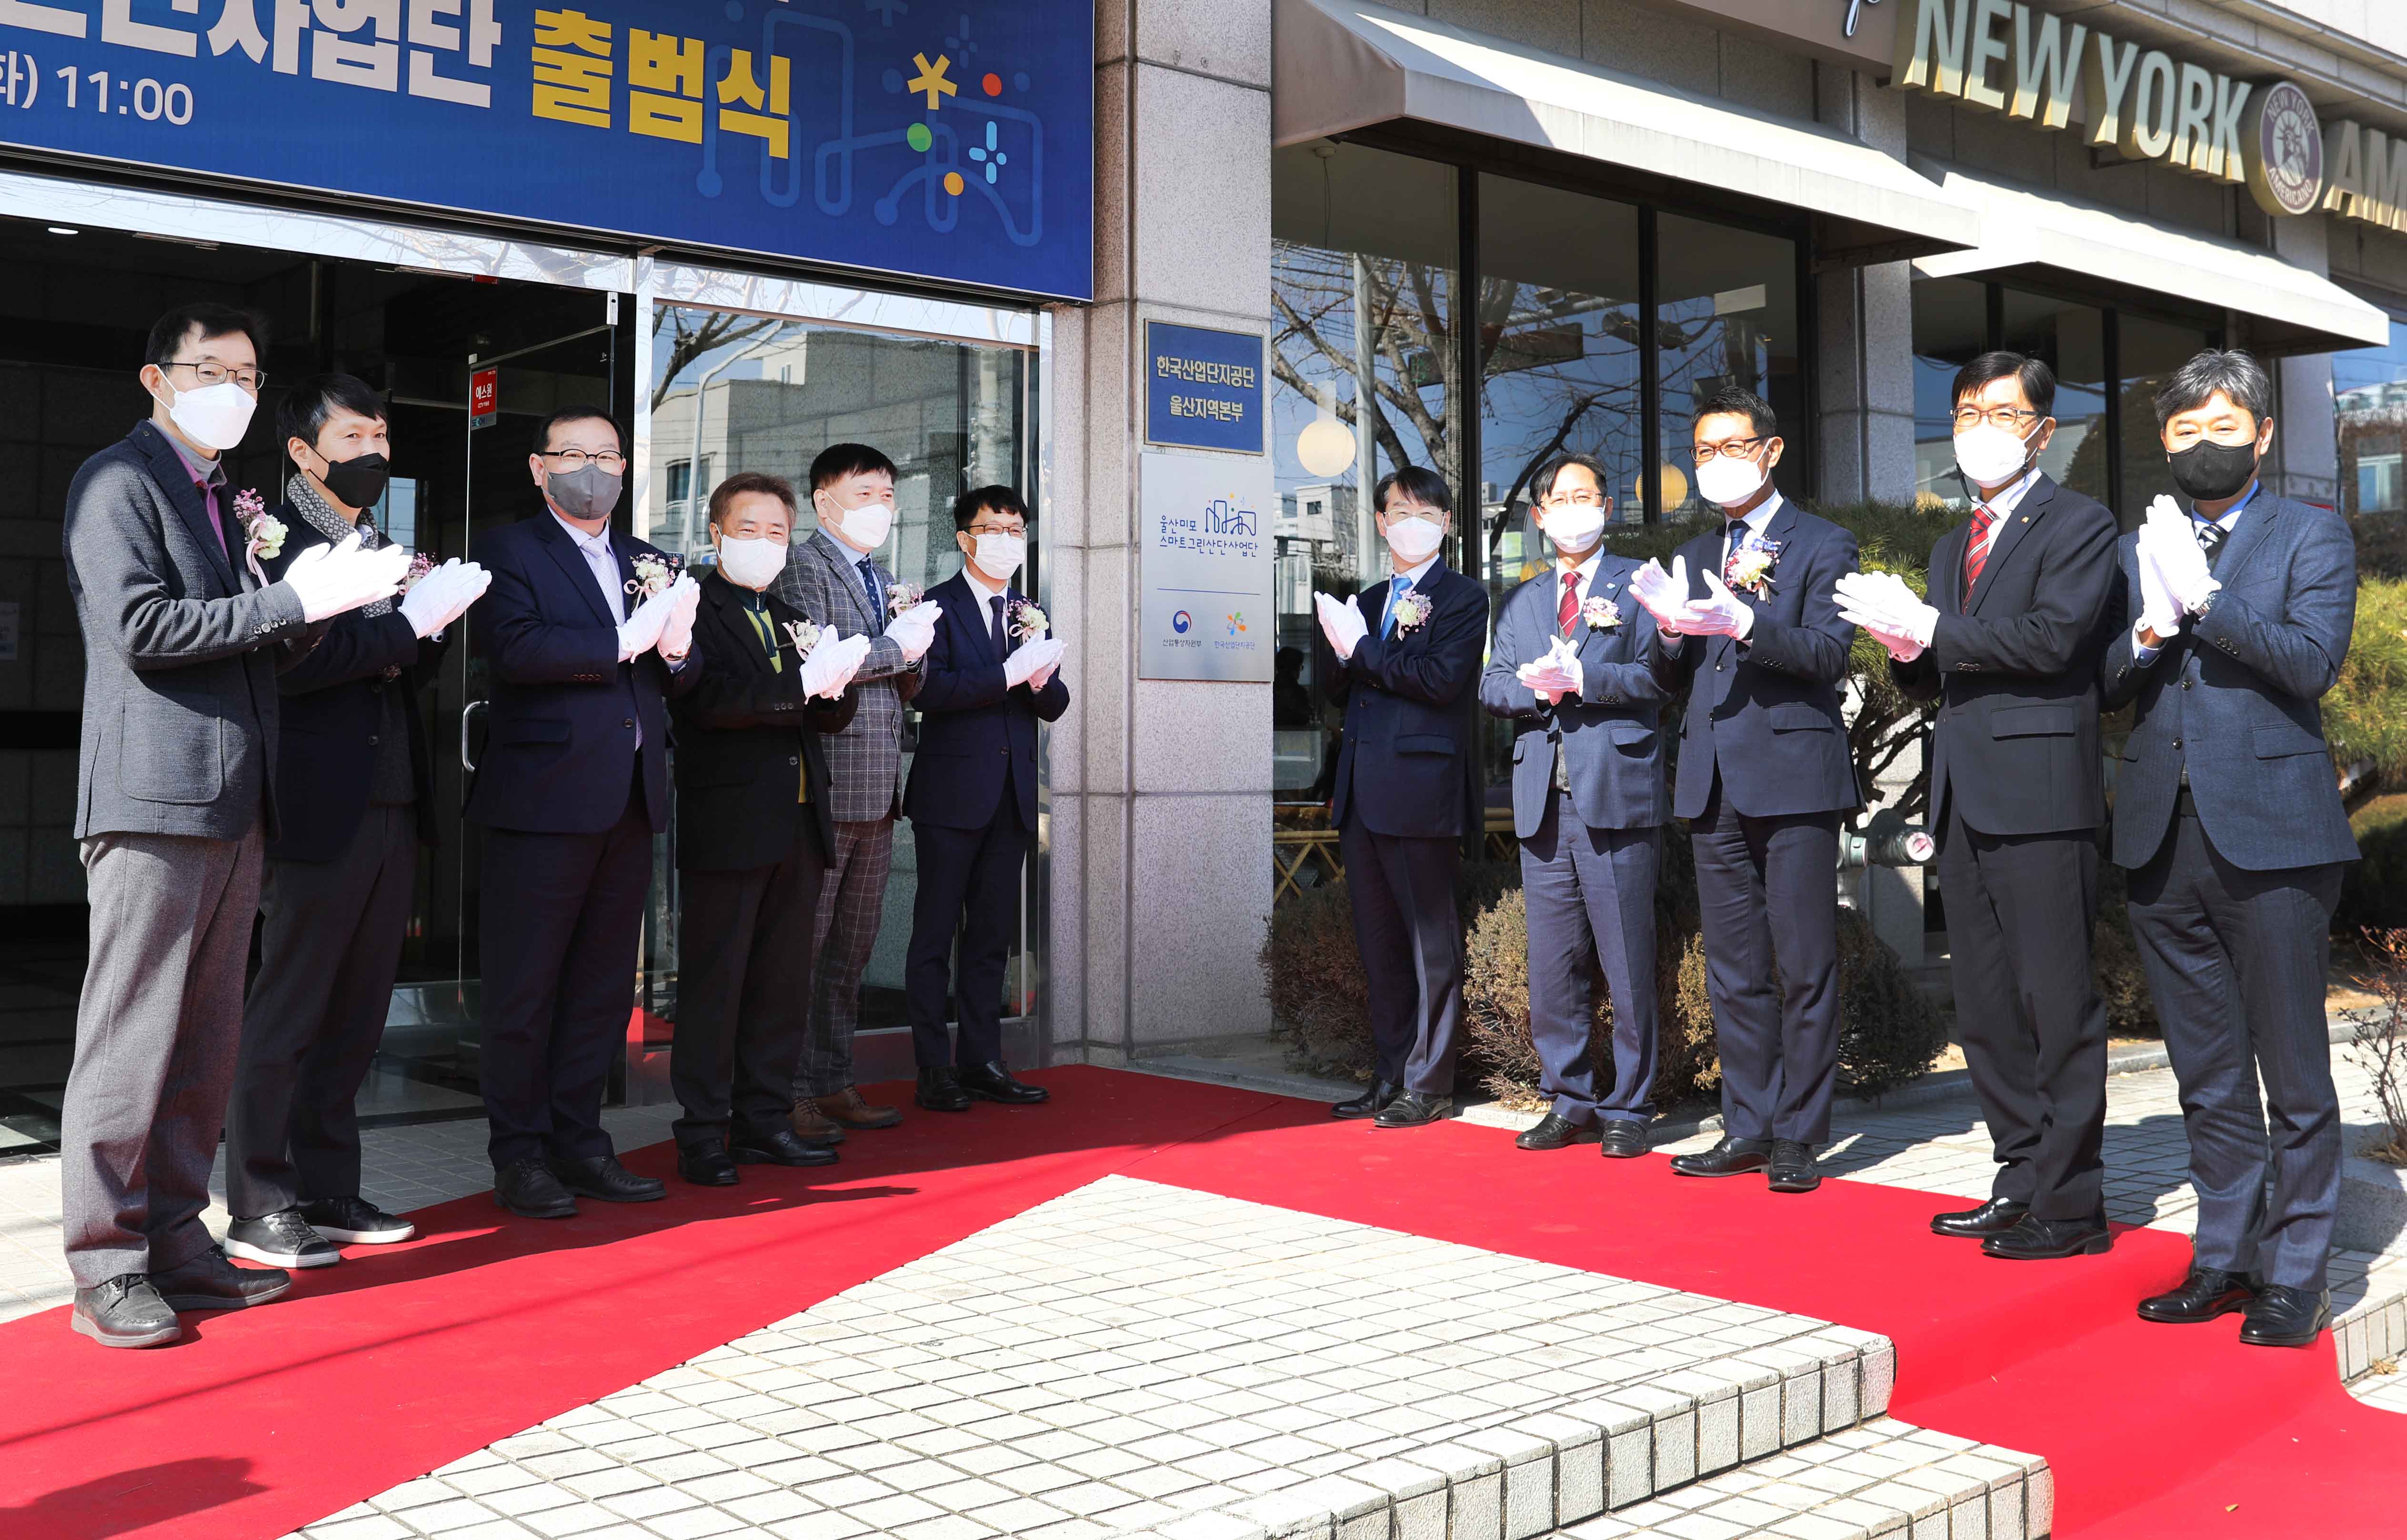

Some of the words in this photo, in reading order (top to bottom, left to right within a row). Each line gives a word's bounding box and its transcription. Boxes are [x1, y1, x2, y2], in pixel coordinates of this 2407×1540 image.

[56, 66, 193, 125] 11:00
[531, 8, 791, 160] 출범식
[1903, 0, 2087, 129] NEW
[2094, 31, 2253, 182] YORK
[2267, 92, 2288, 123] NEW
[2291, 92, 2315, 134] YORK
[2268, 167, 2314, 206] AMERICANO
[1156, 355, 1255, 389] 한국산업단지공단
[475, 382, 492, 400] 에스원
[1170, 395, 1243, 422] 울산지역본부
[1160, 535, 1258, 557] 스마트그린산단사업단
[1163, 639, 1202, 648] 산업통상자원부
[1214, 640, 1255, 650] 한국산업단지공단
